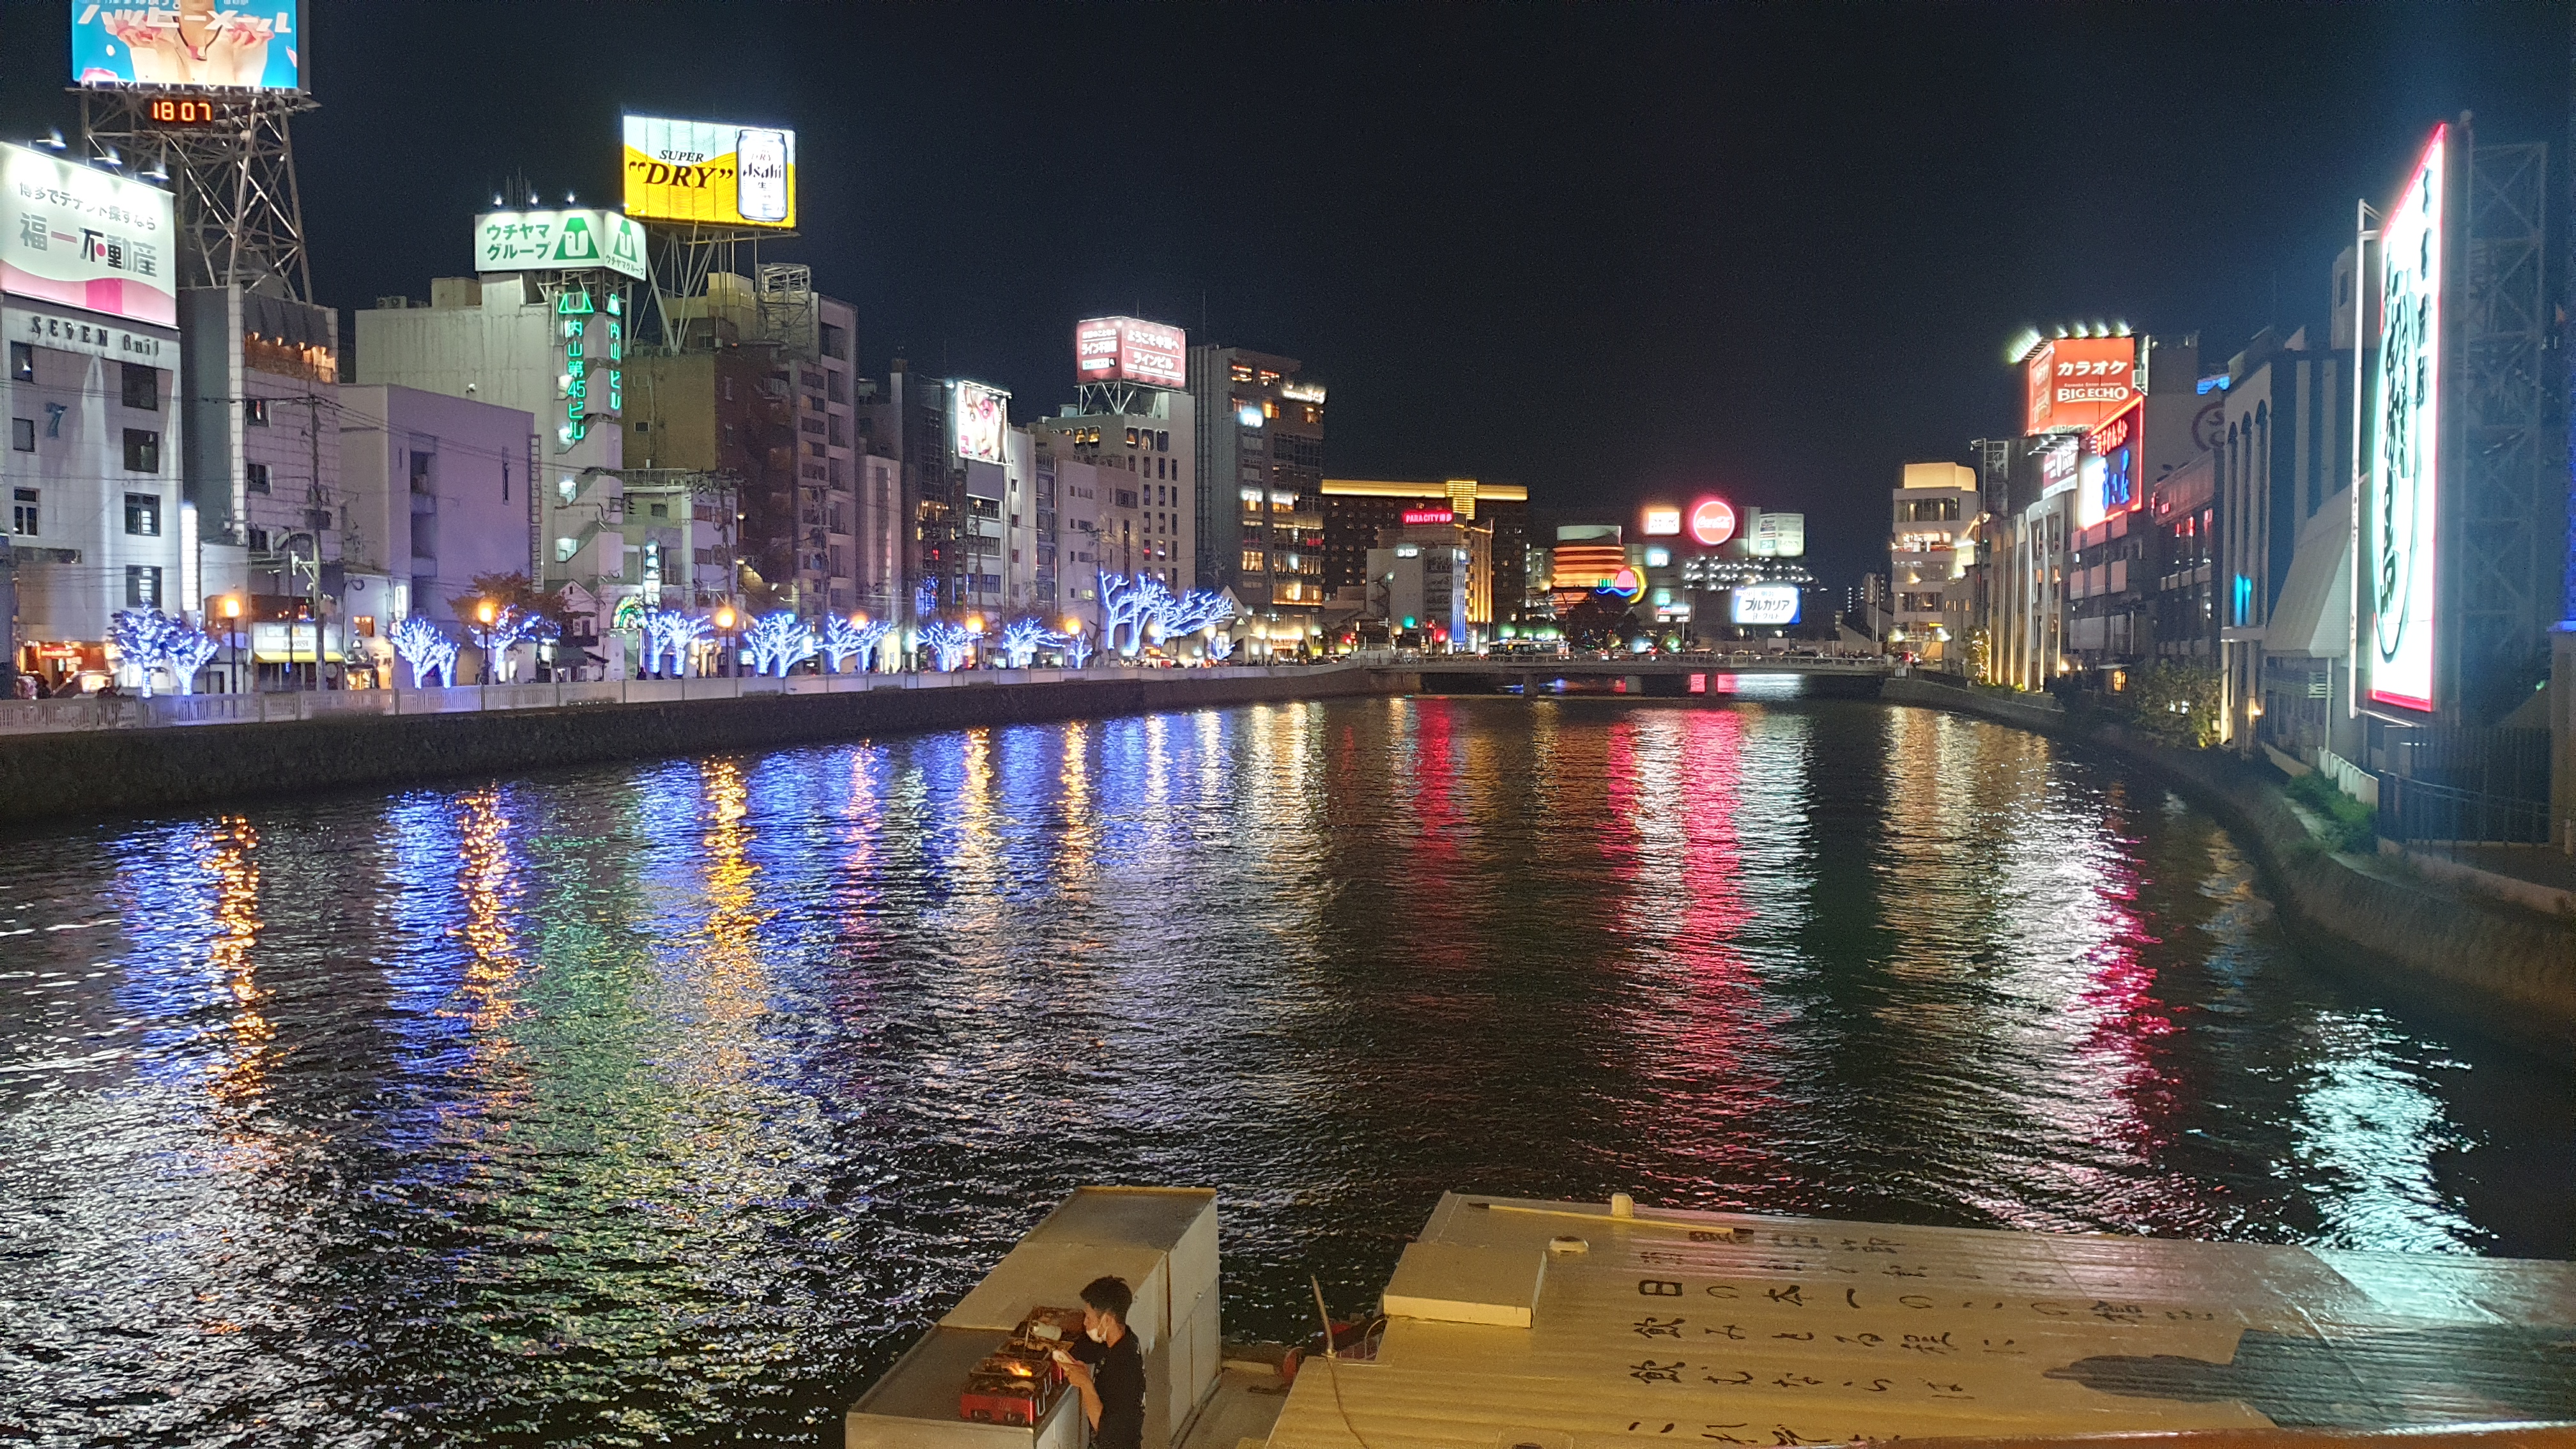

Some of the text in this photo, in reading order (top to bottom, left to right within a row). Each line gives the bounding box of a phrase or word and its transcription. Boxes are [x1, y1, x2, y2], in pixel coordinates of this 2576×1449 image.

[659, 150, 704, 163] SUPER
[743, 163, 781, 180] Asahi
[20, 181, 155, 231] 博多でテナント探すなら
[486, 223, 550, 241] ウチヤマ
[20, 212, 157, 277] 福一不動産
[486, 241, 551, 261] グループ
[606, 254, 644, 275] ウチヤマグループ
[30, 316, 107, 347] SEVEN
[610, 321, 621, 411] 内山ビル
[2057, 360, 2128, 376] カラオケ
[567, 319, 586, 440] 内山第45ビル
[2057, 387, 2129, 402] BIG ECHO
[1696, 516, 1732, 530] Coca-Cola
[1745, 597, 1790, 611] ブルガリア
